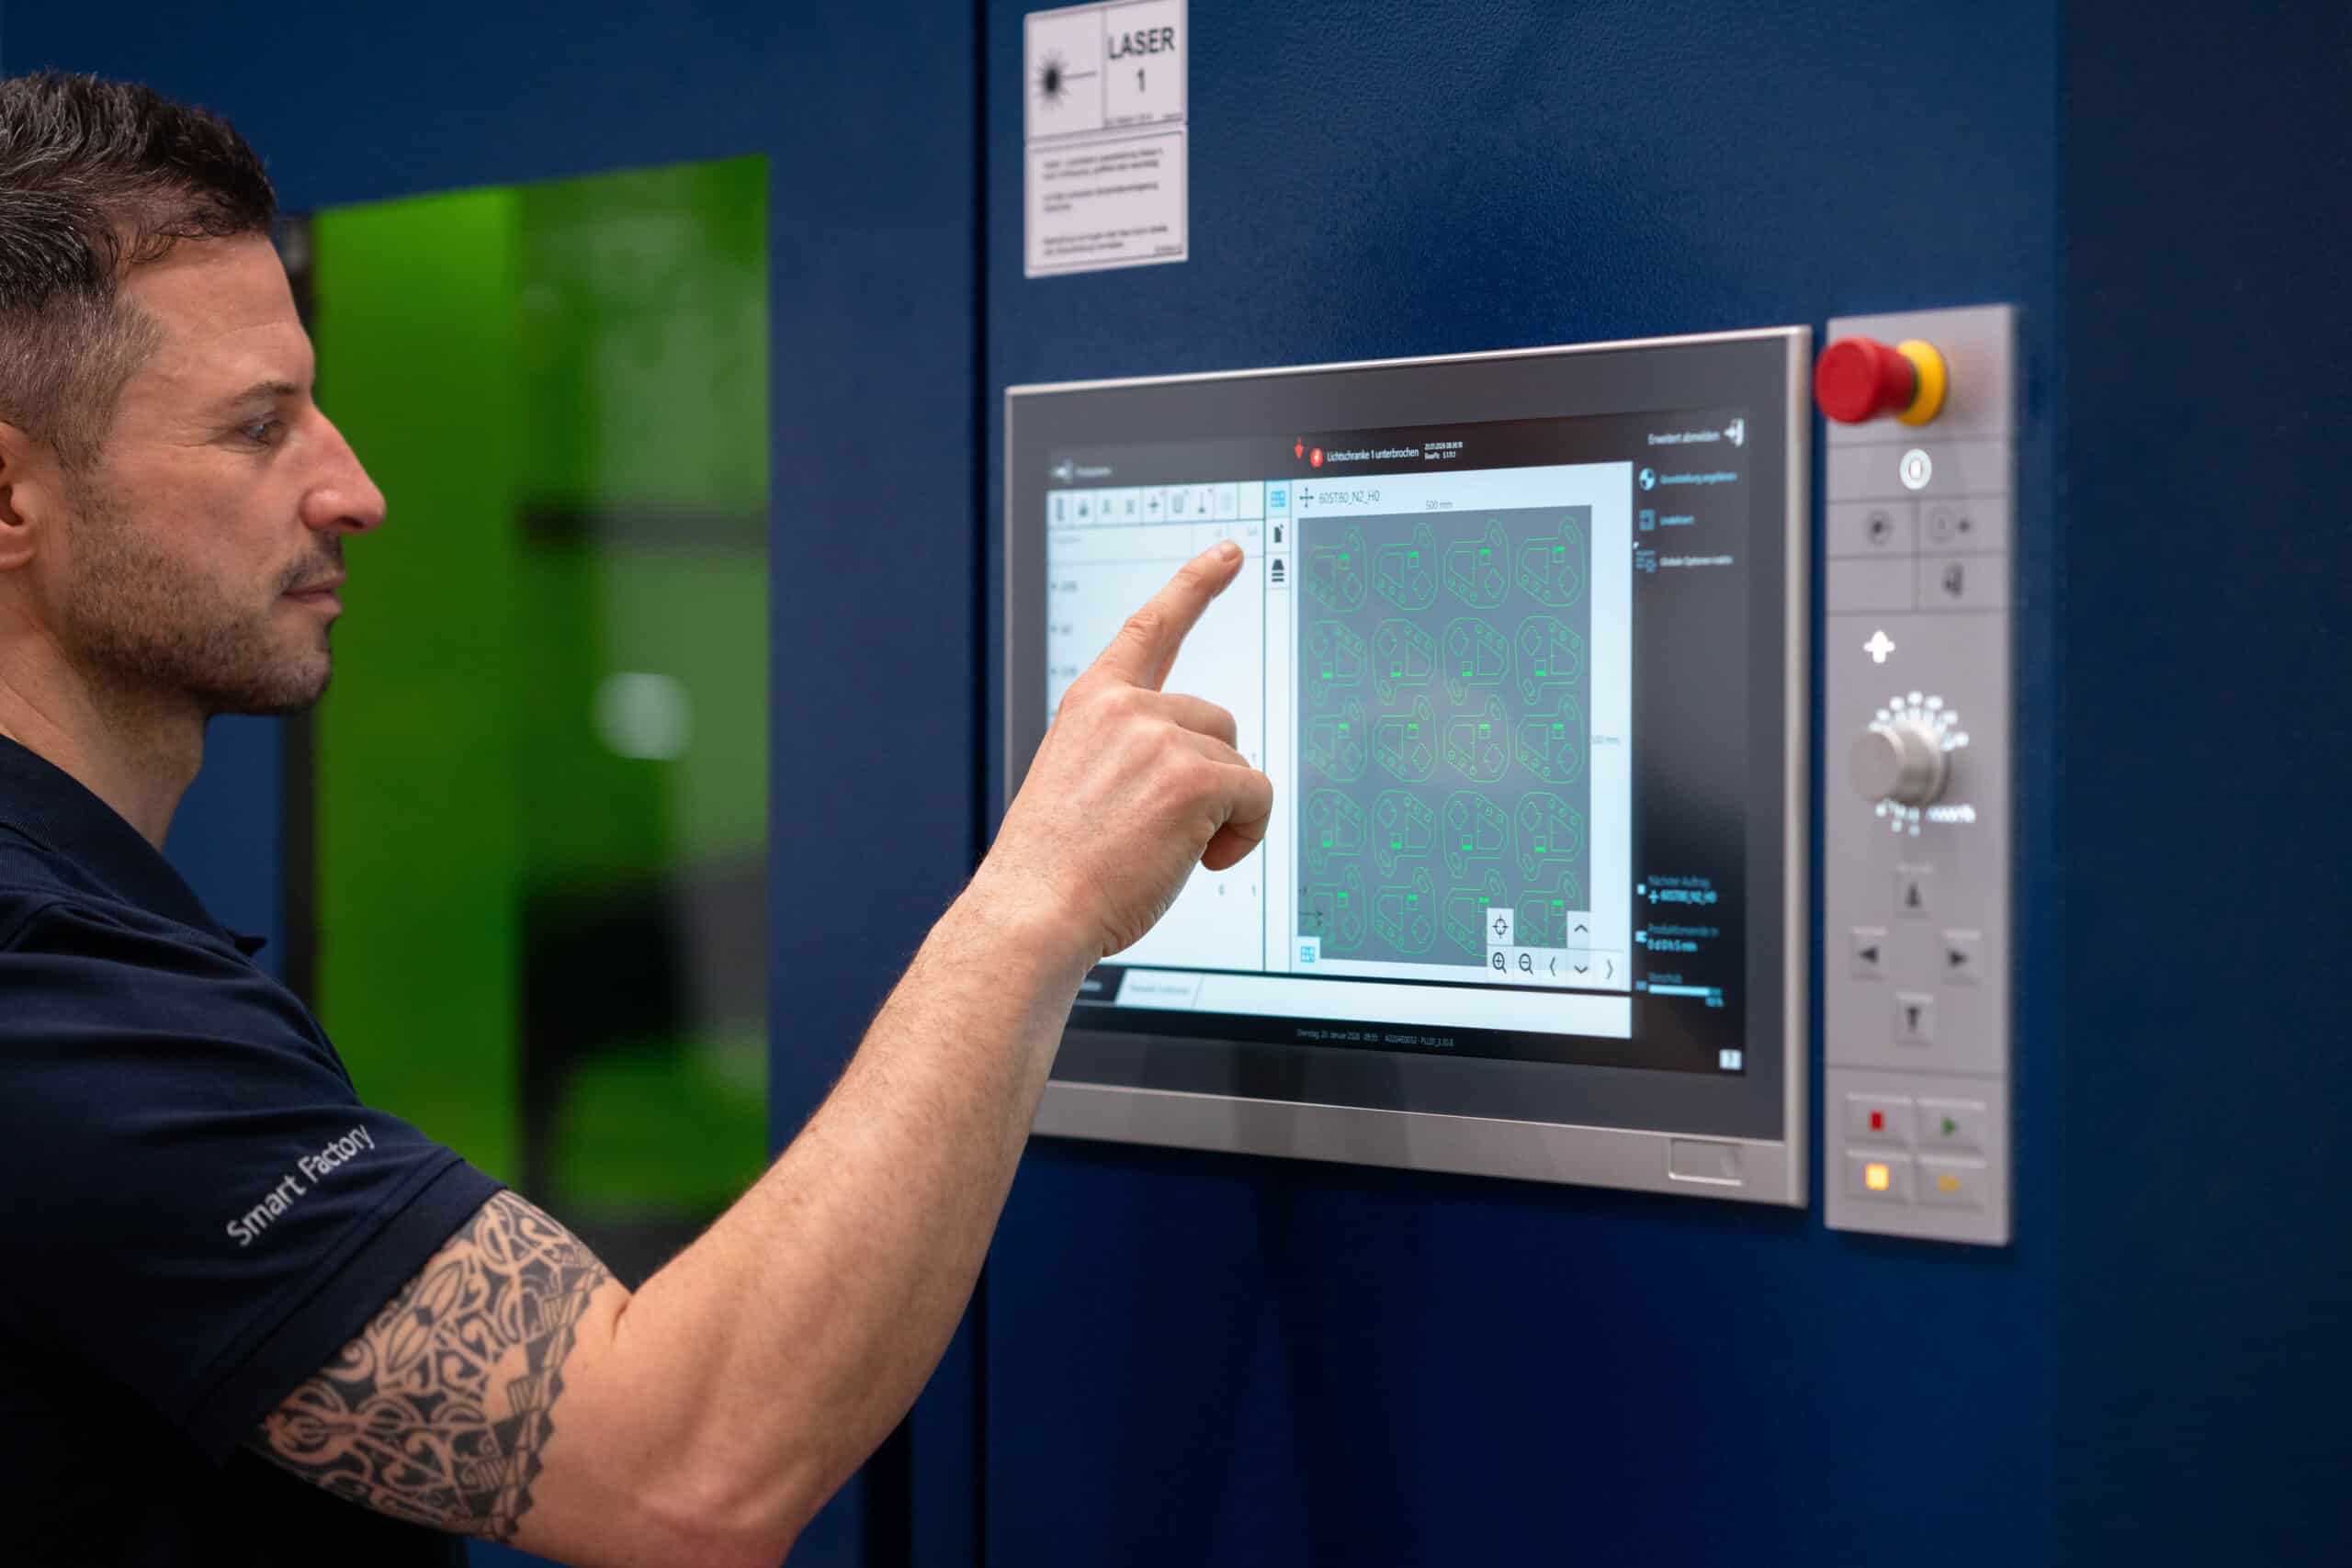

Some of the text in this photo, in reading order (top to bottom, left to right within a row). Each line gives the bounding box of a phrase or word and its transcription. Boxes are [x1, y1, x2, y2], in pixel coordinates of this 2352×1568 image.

[1108, 27, 1175, 60] LASER
[1136, 69, 1146, 92] 1
[1375, 446, 1419, 459] unterbrochen
[227, 1123, 376, 1247] Smart Factory
